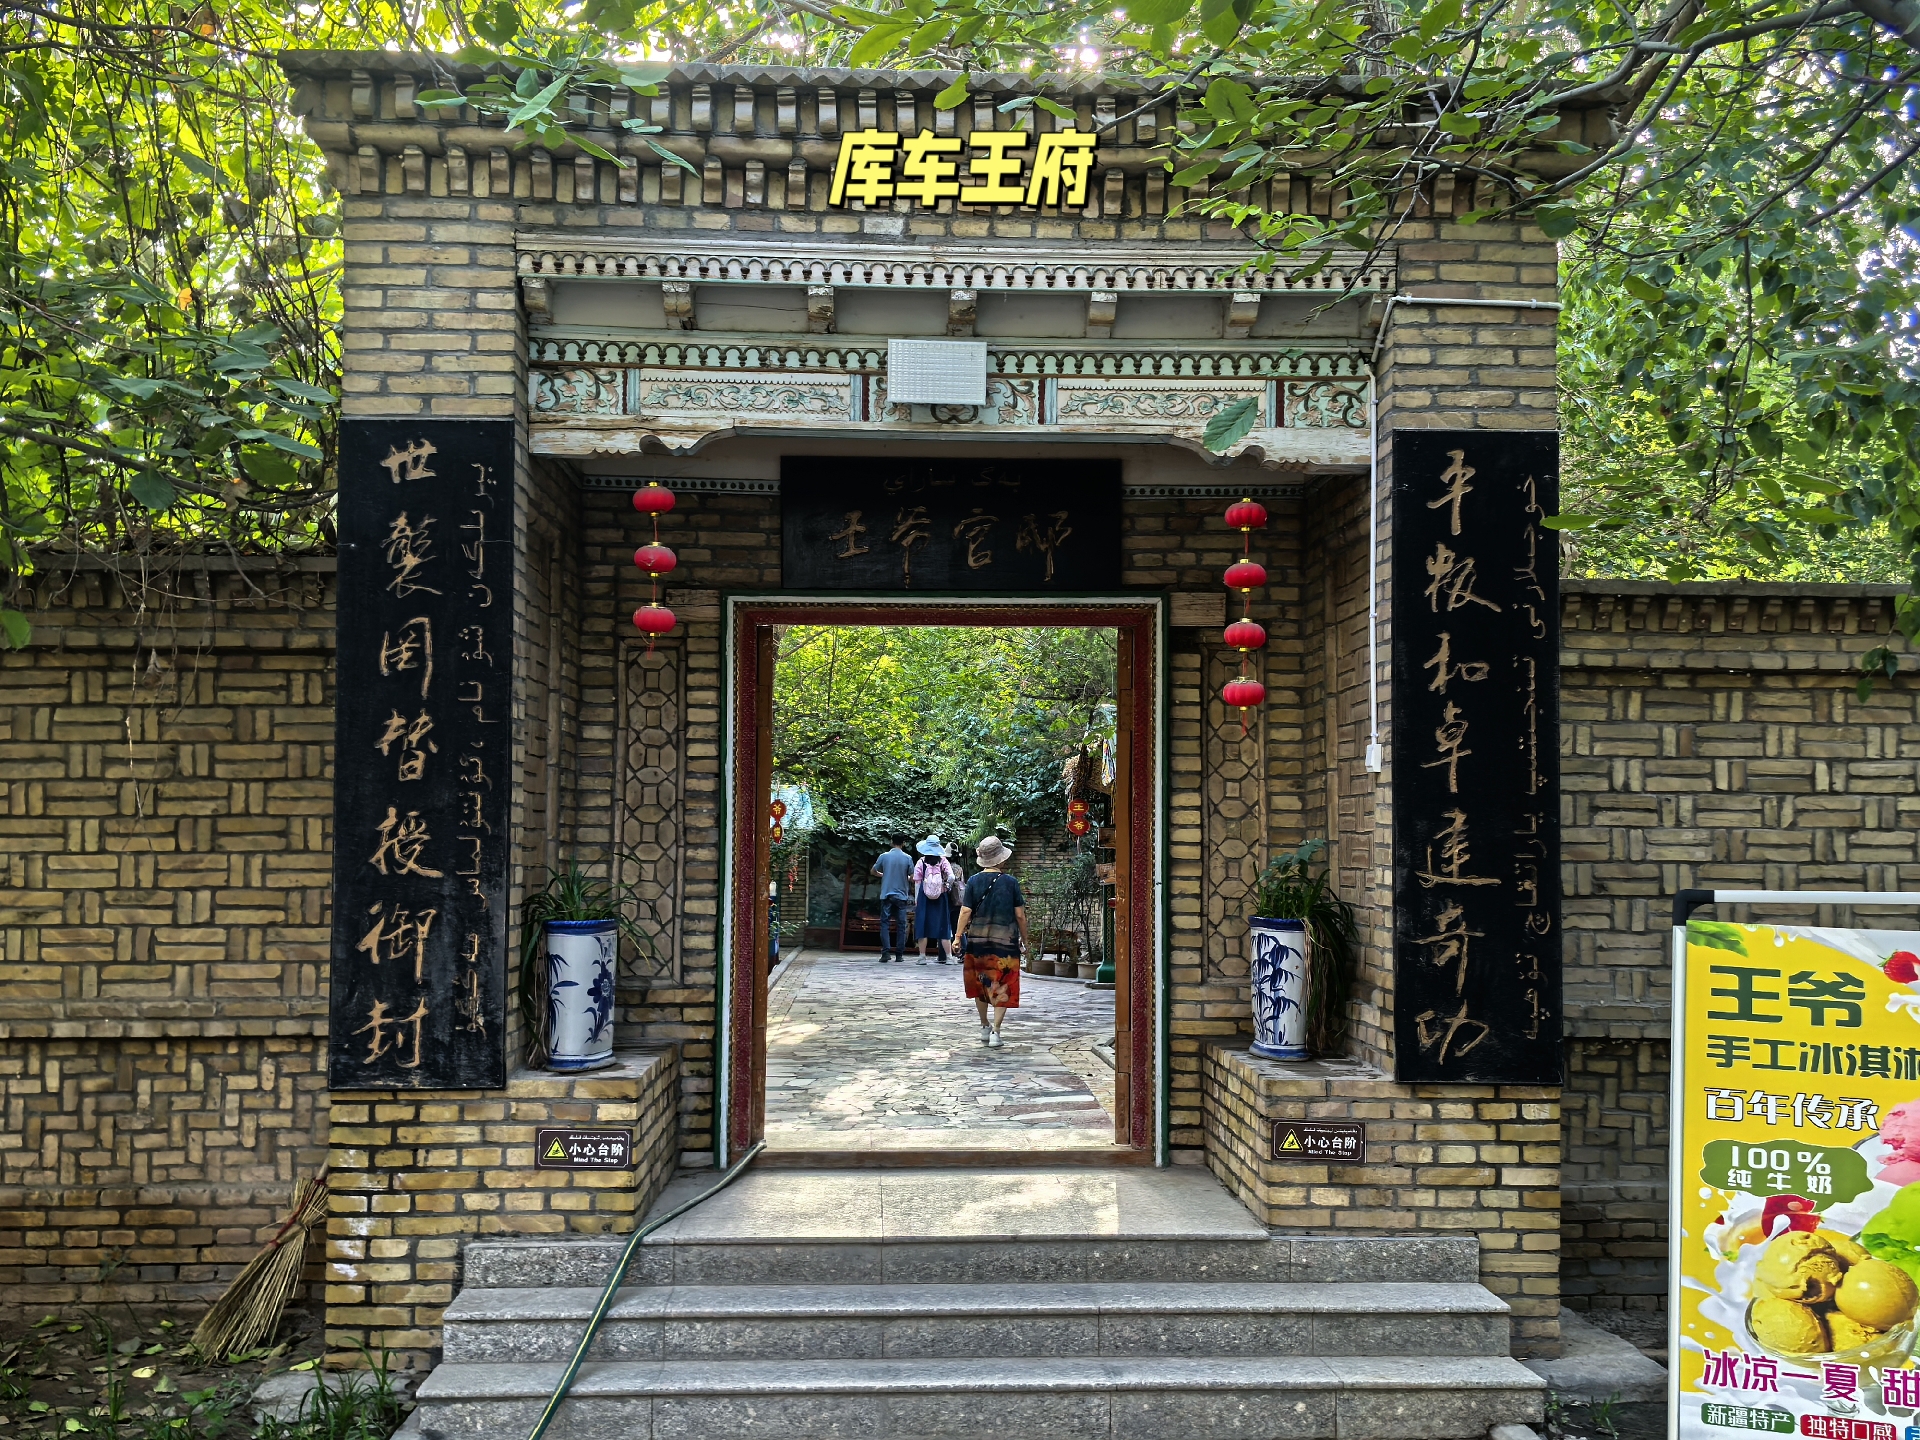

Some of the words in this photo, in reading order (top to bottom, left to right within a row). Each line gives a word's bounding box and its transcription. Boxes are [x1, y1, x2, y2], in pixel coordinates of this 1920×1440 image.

[1706, 964, 1866, 1028] 王爷
[1703, 1086, 1880, 1131] 百年传承
[568, 1142, 624, 1156] 小心台阶
[1303, 1134, 1357, 1149] 小心台阶
[1731, 1145, 1831, 1174] 100%
[1727, 1168, 1832, 1195] 纯牛奶
[1702, 1349, 1860, 1402] 冰凉一夏
[1707, 1403, 1791, 1431] 新疆特产
[1807, 1415, 1894, 1440] 独特口感
